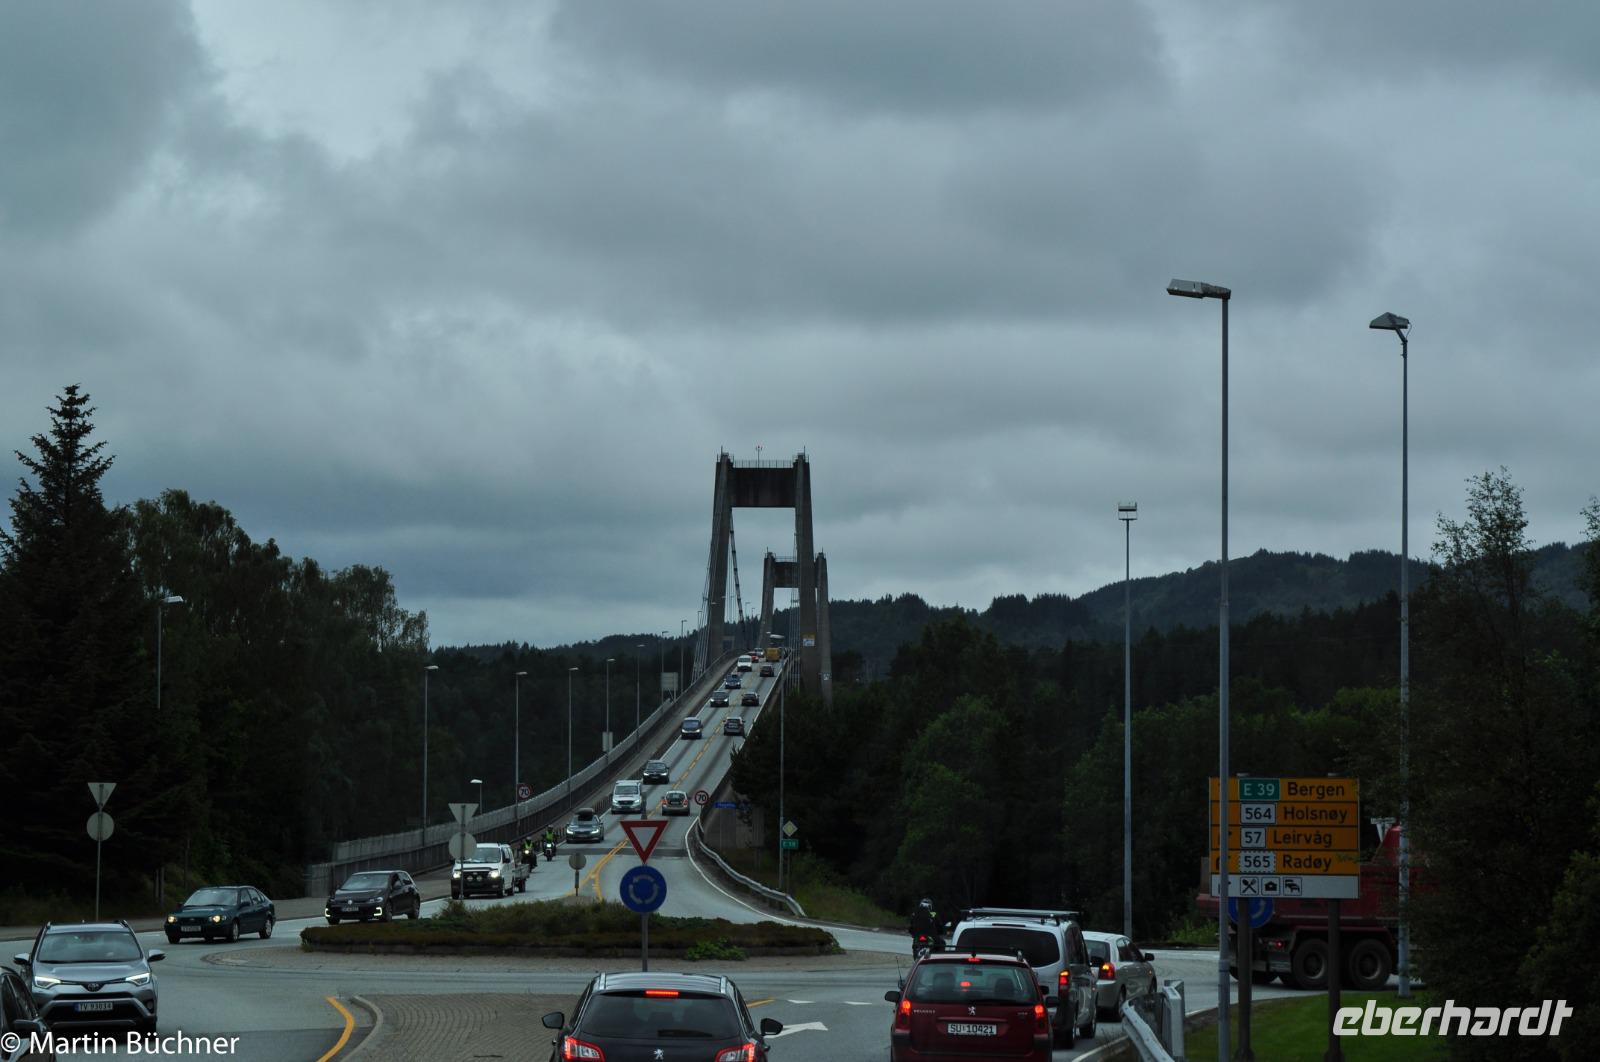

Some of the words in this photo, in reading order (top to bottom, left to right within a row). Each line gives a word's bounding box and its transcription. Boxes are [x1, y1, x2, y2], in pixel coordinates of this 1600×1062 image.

[520, 787, 530, 796] 70
[1243, 783, 1252, 796] E
[1256, 783, 1276, 796] 39
[1287, 781, 1345, 798] Bergen
[697, 794, 708, 802] 70
[1245, 807, 1272, 820] 564
[1283, 807, 1348, 824] Holsnøy
[1244, 831, 1262, 844] 57
[1273, 829, 1333, 847] Leirvåg
[1243, 855, 1271, 868] 565
[1282, 855, 1332, 872] Radøy
[950, 1024, 961, 1033] SU
[966, 1025, 994, 1034] 10421
